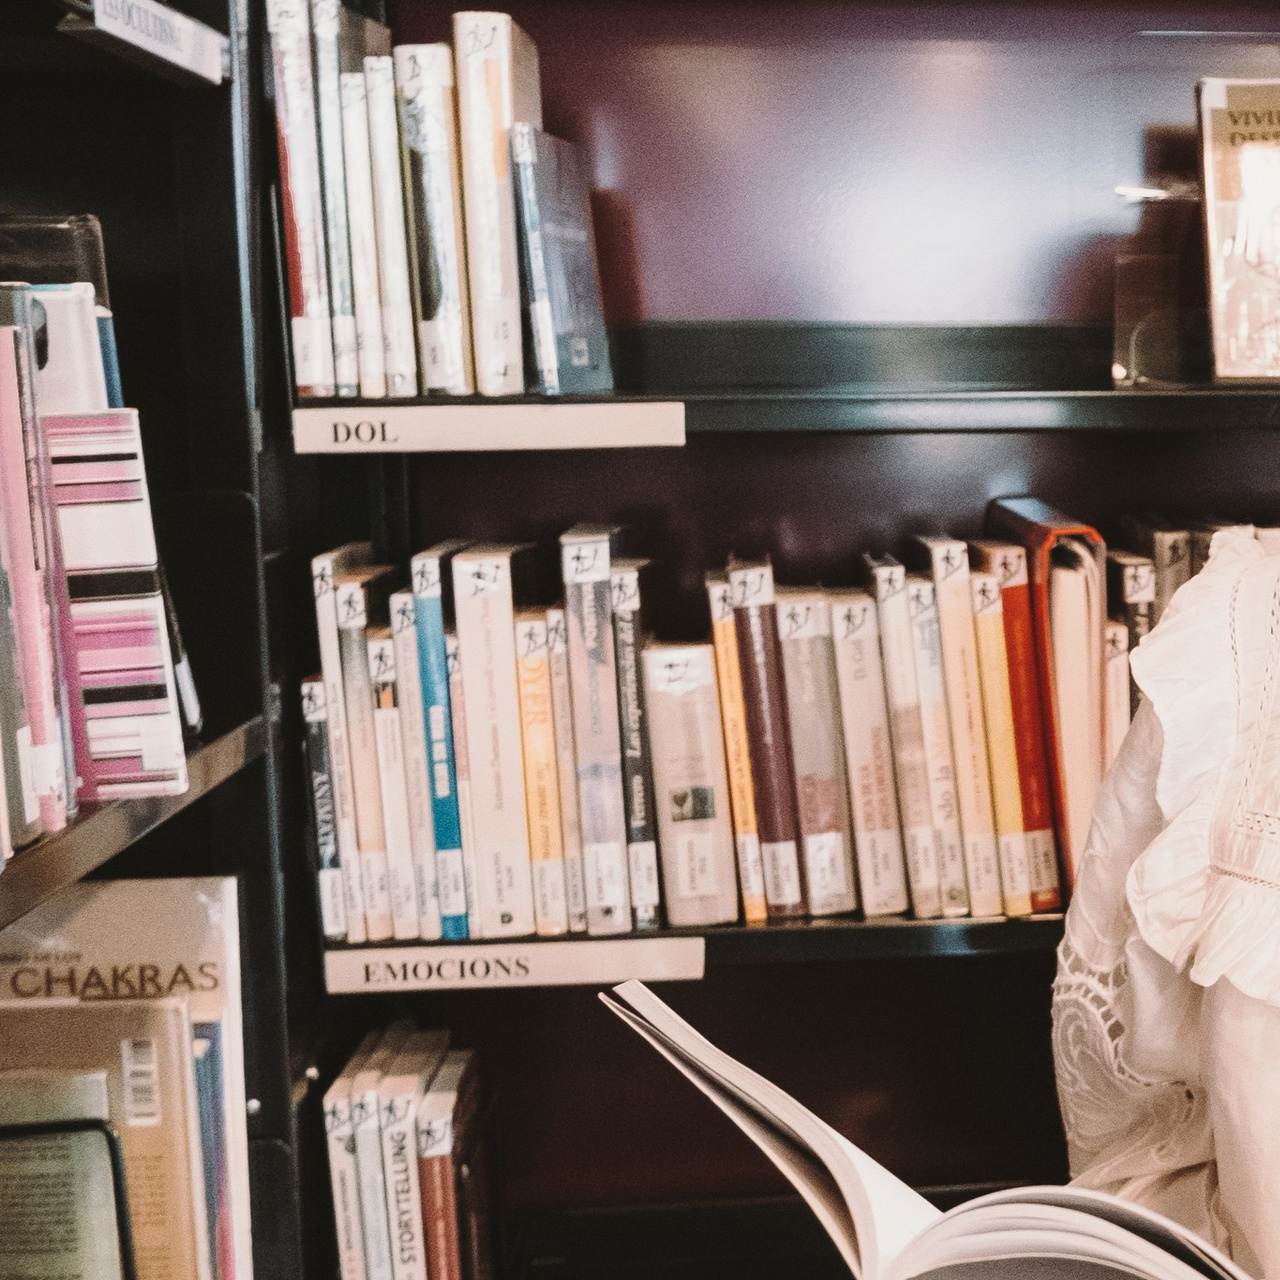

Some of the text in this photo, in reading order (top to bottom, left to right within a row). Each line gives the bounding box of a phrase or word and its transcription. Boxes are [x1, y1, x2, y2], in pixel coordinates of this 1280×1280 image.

[331, 420, 399, 445] DOL
[10, 961, 219, 999] CHAKRAS
[363, 955, 530, 985] EMOCIONS
[387, 1129, 418, 1266] STORYTELLING
